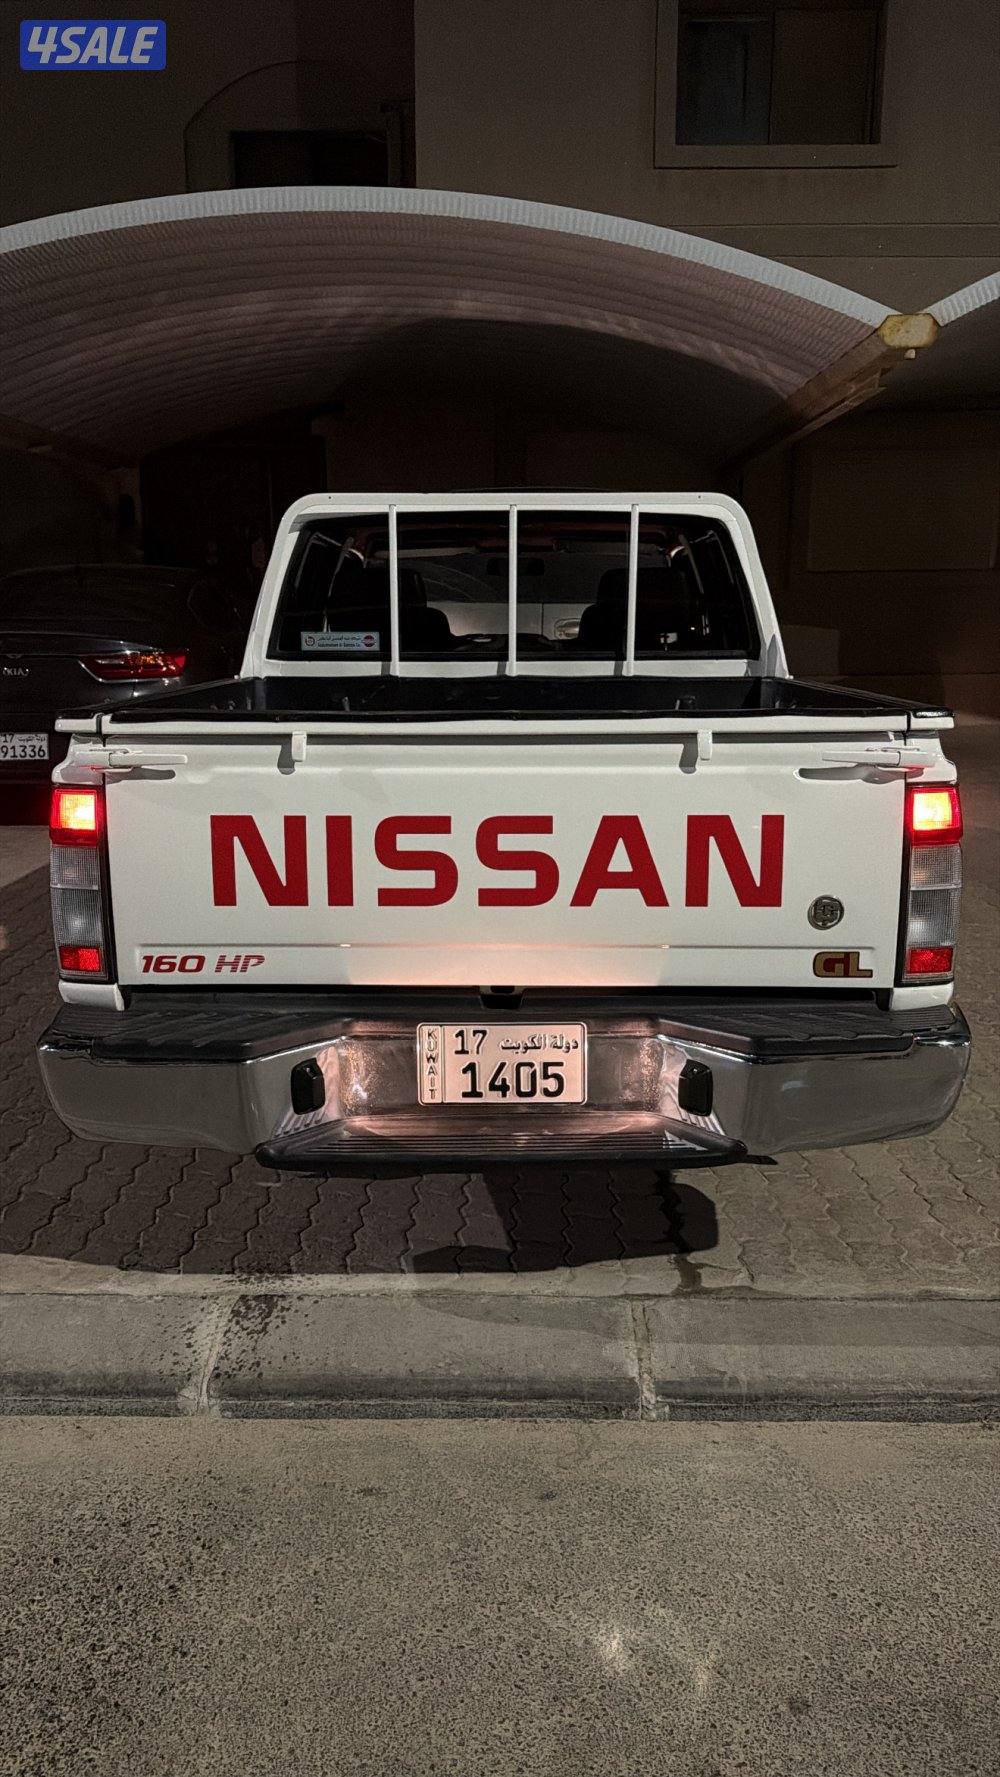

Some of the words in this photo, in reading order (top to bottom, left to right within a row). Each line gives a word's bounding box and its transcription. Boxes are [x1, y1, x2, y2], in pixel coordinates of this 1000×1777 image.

[5, 667, 26, 676] KIA
[3, 733, 15, 743] 17
[0, 745, 46, 759] 91336
[210, 815, 785, 907] NISSAN
[142, 955, 206, 973] 160
[215, 955, 265, 973] HP
[813, 951, 873, 978] GL
[454, 1029, 487, 1055] 17
[500, 1033, 547, 1055] الكويت
[551, 1034, 579, 1054] دولة
[425, 1028, 438, 1100] KUWAIT
[461, 1062, 564, 1098] 1405
